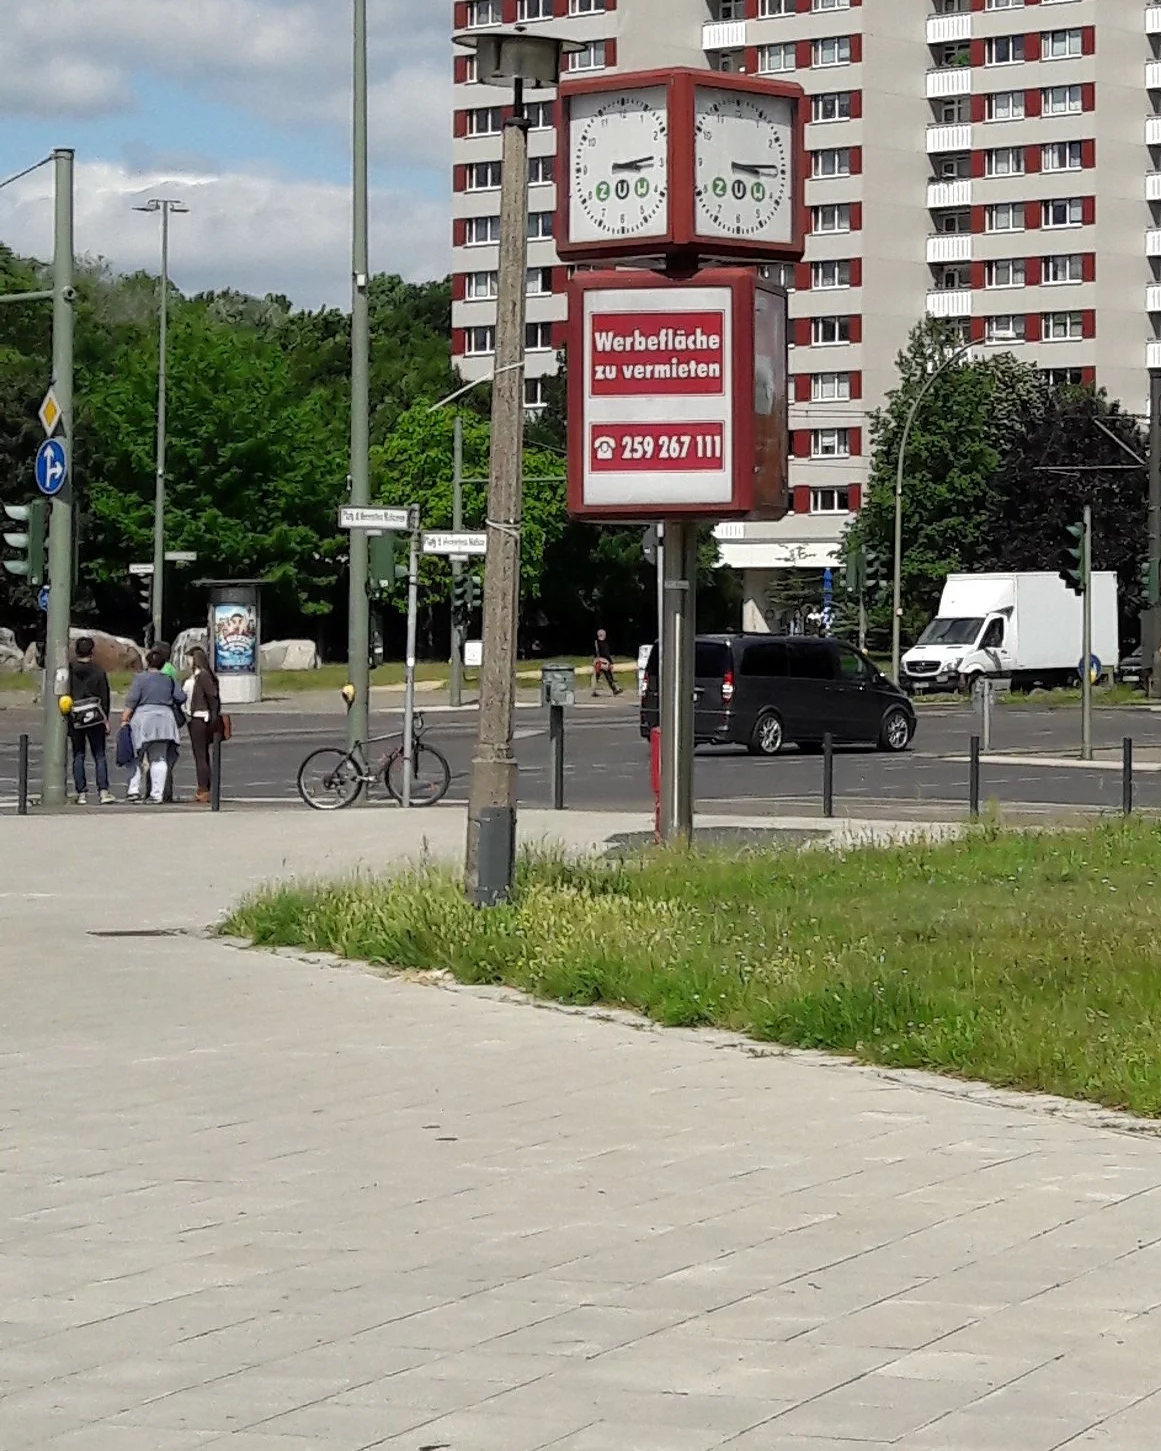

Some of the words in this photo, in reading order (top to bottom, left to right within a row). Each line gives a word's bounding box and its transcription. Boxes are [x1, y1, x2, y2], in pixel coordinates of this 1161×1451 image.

[594, 327, 720, 352] Werbefläche
[594, 364, 617, 380] zu
[622, 356, 721, 380] vermieten
[621, 435, 655, 460] 259
[658, 435, 692, 459] 267
[696, 434, 721, 458] 111
